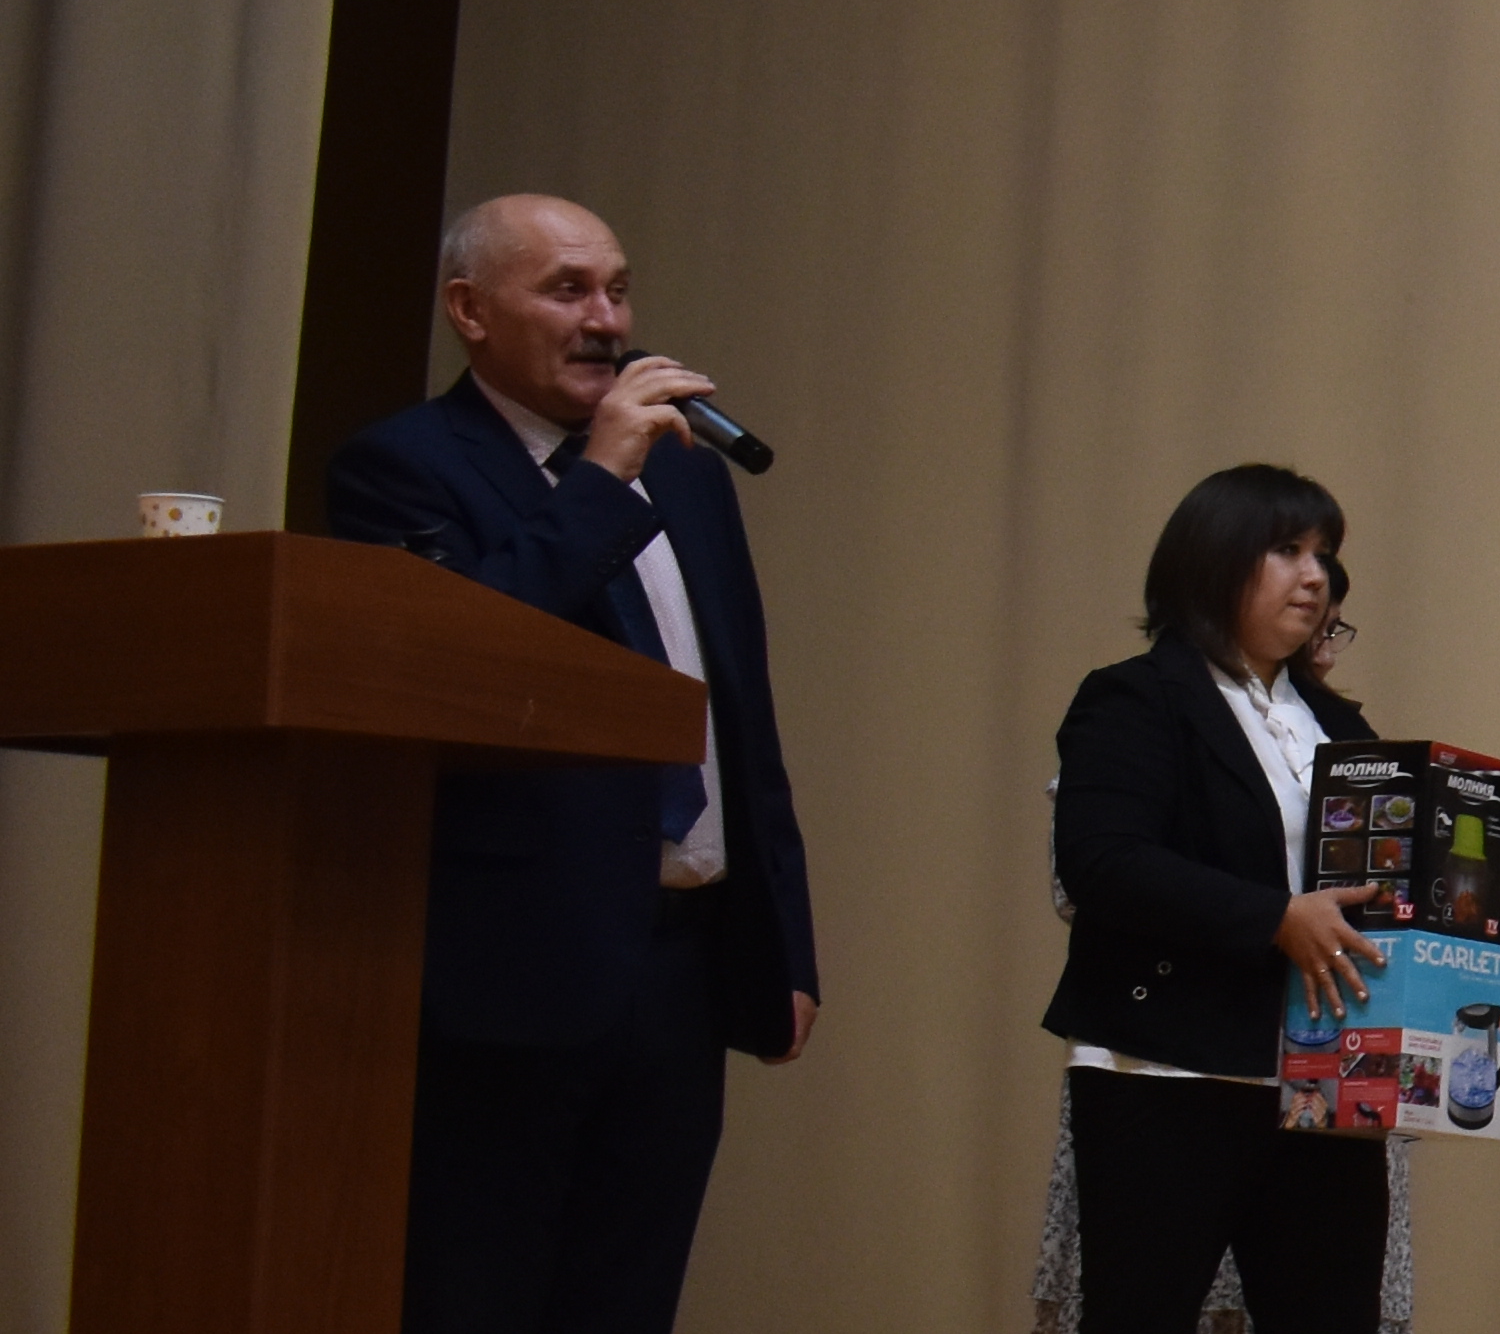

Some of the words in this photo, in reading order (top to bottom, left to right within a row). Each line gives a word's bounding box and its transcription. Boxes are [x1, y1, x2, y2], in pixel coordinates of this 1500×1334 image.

[1330, 761, 1404, 778] МОЛНИЯ
[1447, 775, 1498, 798] МОЛНИЯ
[1399, 904, 1415, 914] TV
